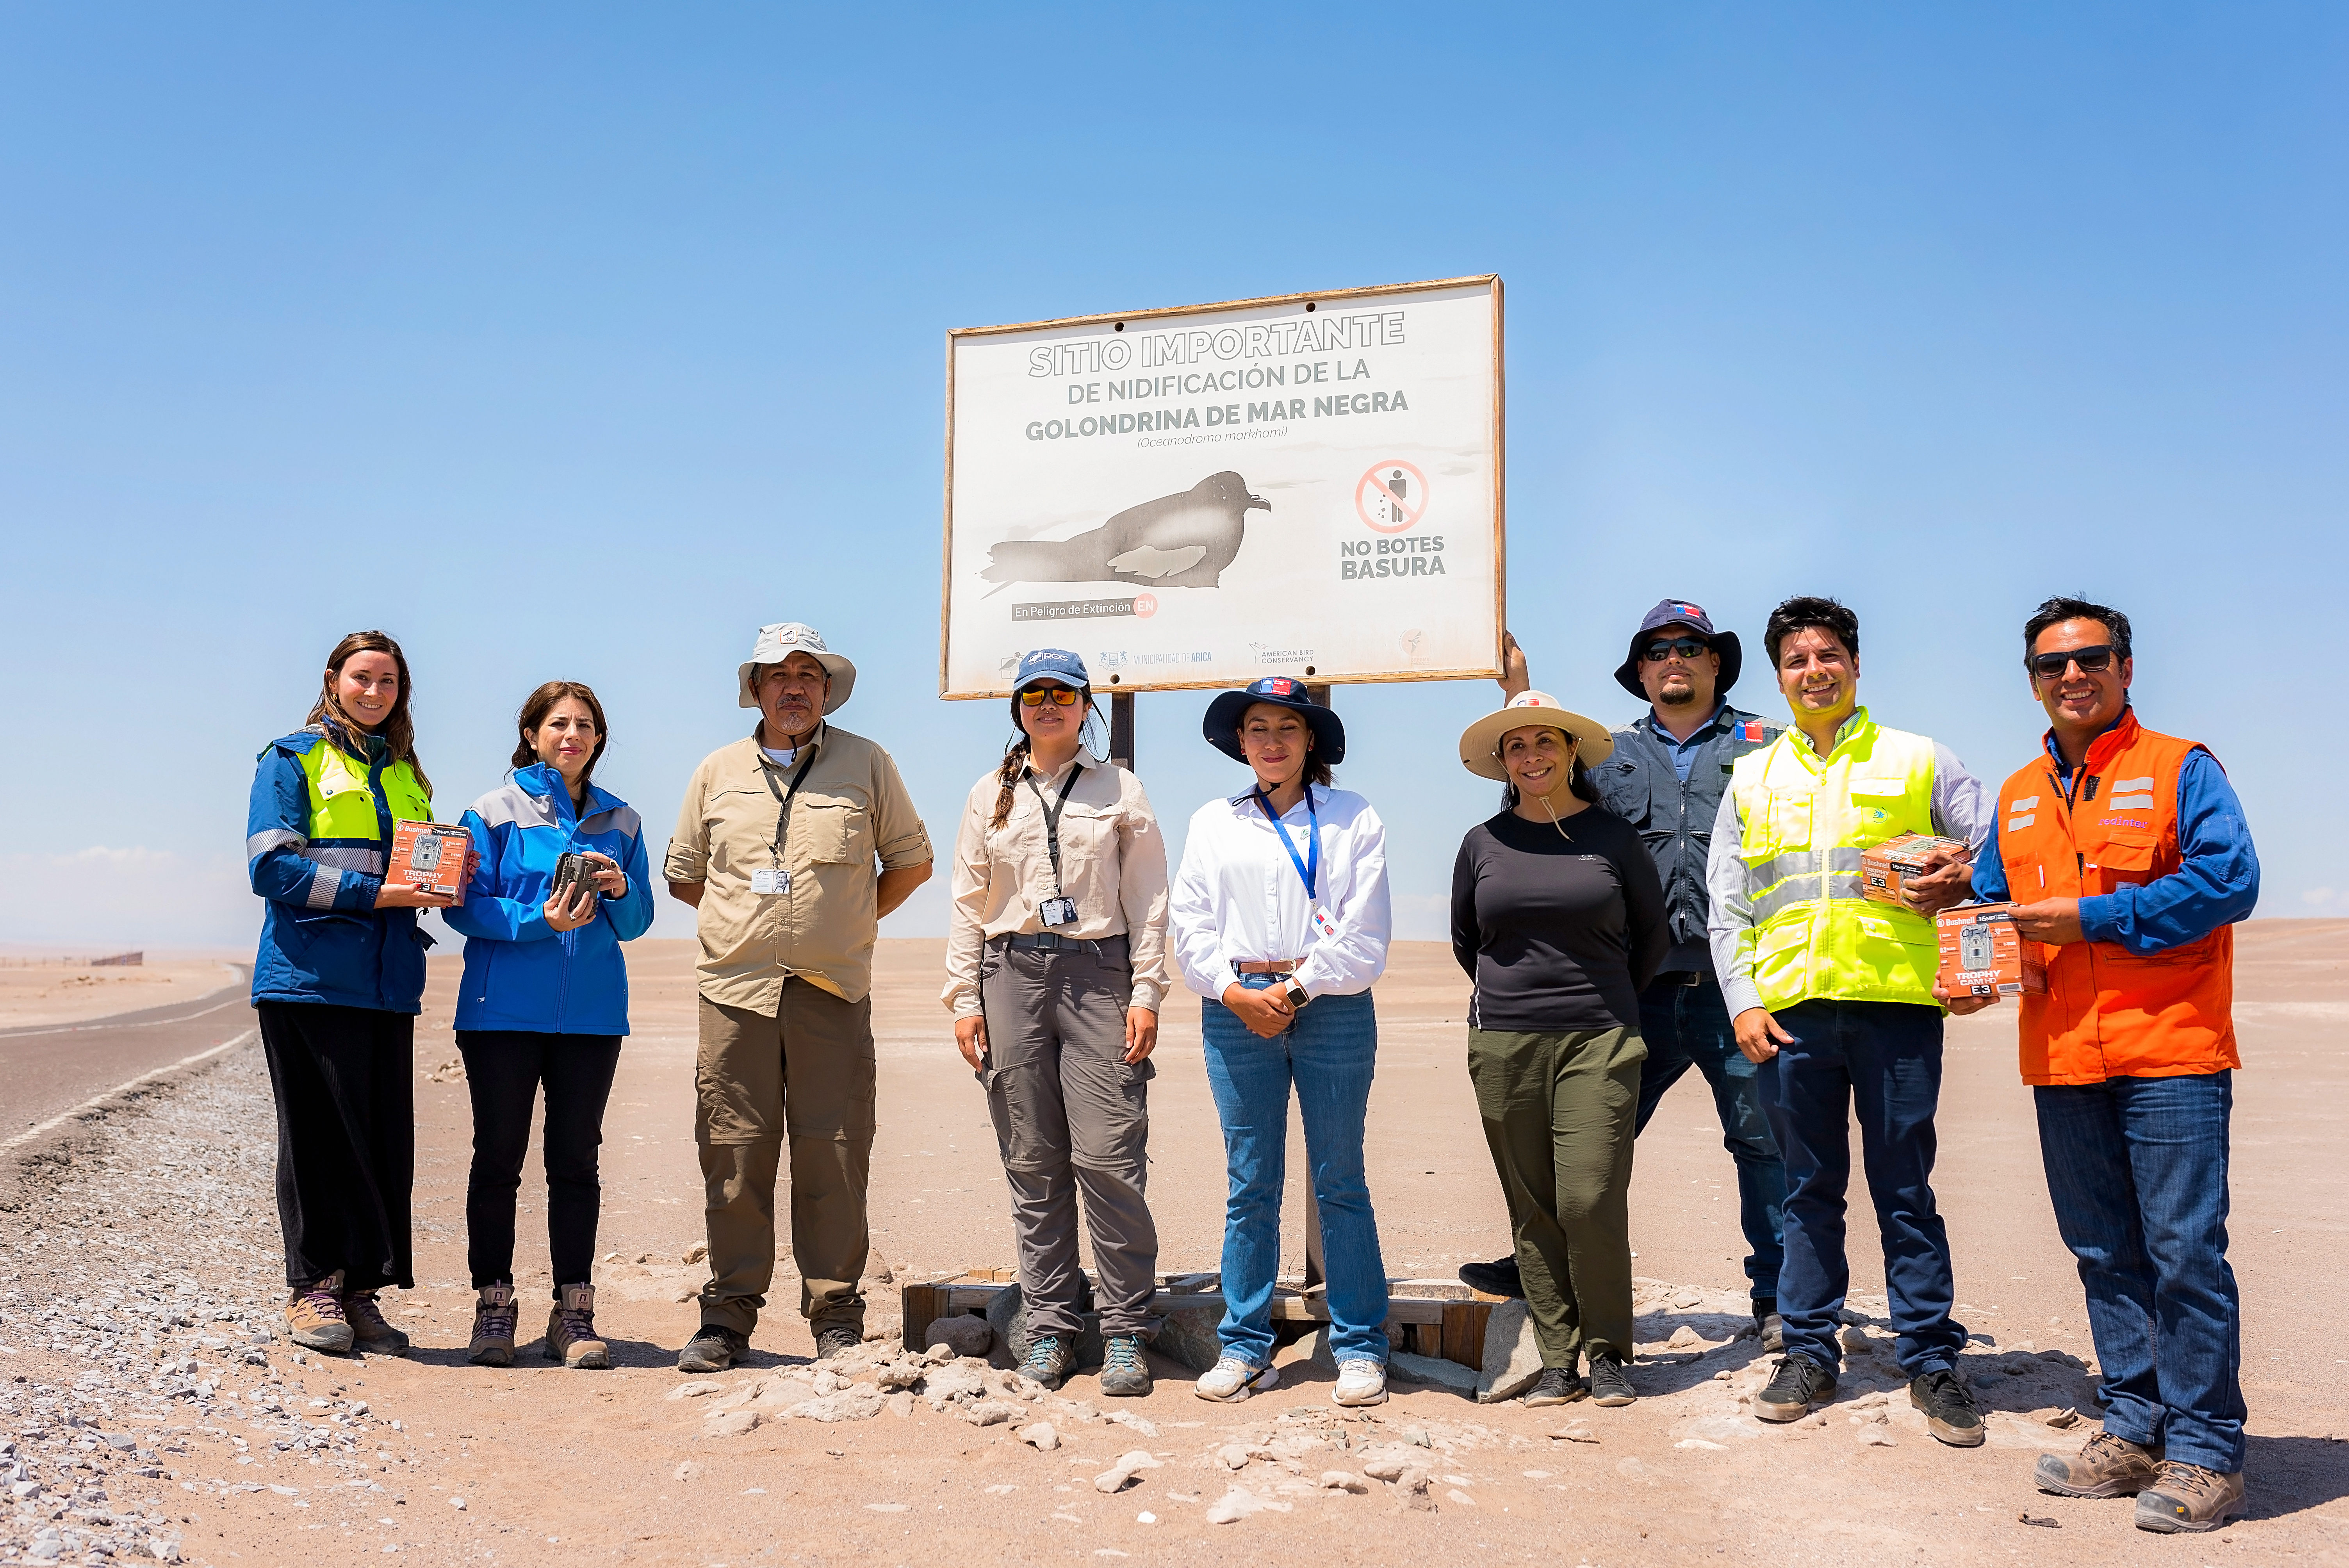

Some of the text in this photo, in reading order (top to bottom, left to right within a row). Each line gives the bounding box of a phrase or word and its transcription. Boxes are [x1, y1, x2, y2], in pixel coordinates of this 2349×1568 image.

[1028, 311, 1405, 378] SITIO IMPORTANTE
[1068, 358, 1371, 404] DE NIDIFICACIÓN DE LA
[1025, 390, 1408, 440] GOLONDRINA DE MAR NEGRA
[1137, 426, 1288, 449] (Oceanodroma markhami)
[1341, 536, 1444, 557] NO BOTES
[1342, 556, 1446, 580] BASURA
[1015, 602, 1130, 618] En Peligro de Extinción
[1137, 600, 1154, 612] EN
[1044, 652, 1068, 661] ROC
[1133, 652, 1212, 665] MUNICIPALIDAD DE ARICA
[2098, 816, 2148, 829] redinter
[405, 825, 431, 834] Bushnell
[1867, 859, 1889, 869] Bushnell
[403, 870, 443, 878] TROPHY
[1864, 866, 1890, 875] TROPHY
[1871, 877, 1885, 887] E3
[1946, 917, 1975, 926] Bushnell
[1955, 970, 2000, 980] TROPHY
[1971, 985, 1991, 994] E3
